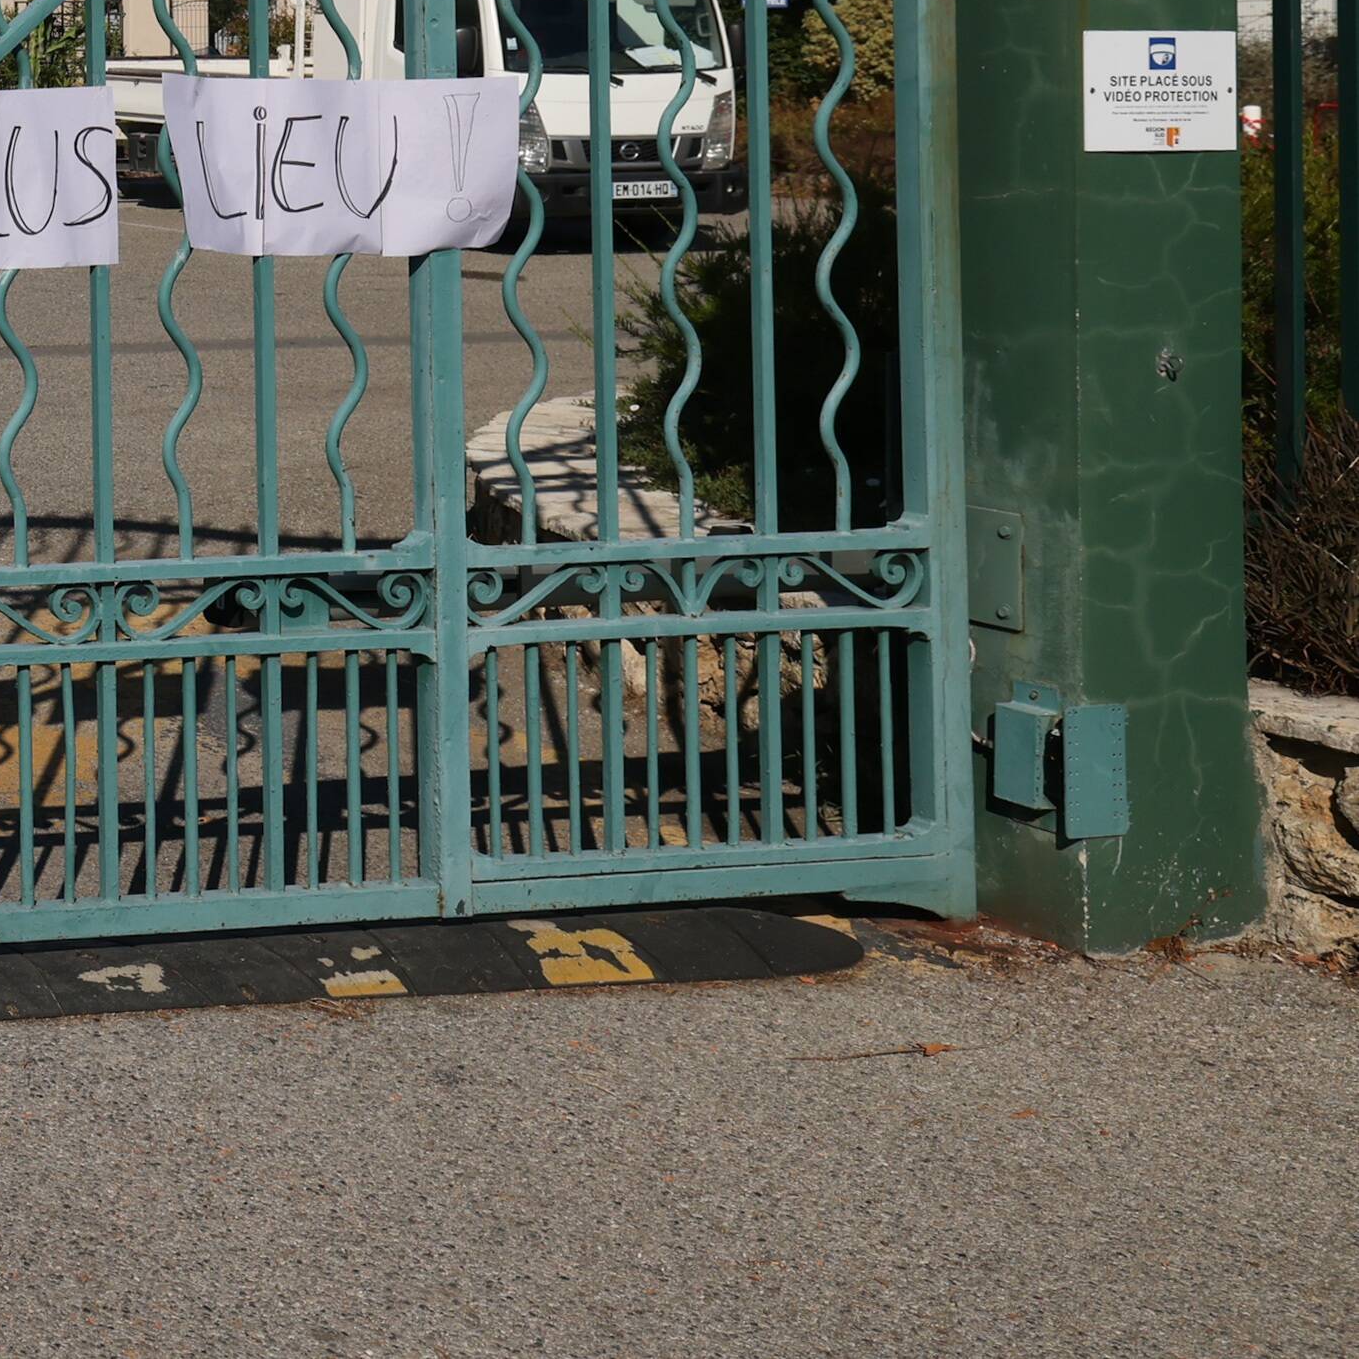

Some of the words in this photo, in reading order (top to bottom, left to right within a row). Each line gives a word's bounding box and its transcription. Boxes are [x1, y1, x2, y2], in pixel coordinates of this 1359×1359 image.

[1109, 75, 1136, 86] SITE
[1139, 73, 1178, 86] PLACÉ
[1181, 75, 1212, 86] SOUS
[1103, 89, 1141, 102] VIDÉO
[1144, 90, 1218, 101] PROTECTION
